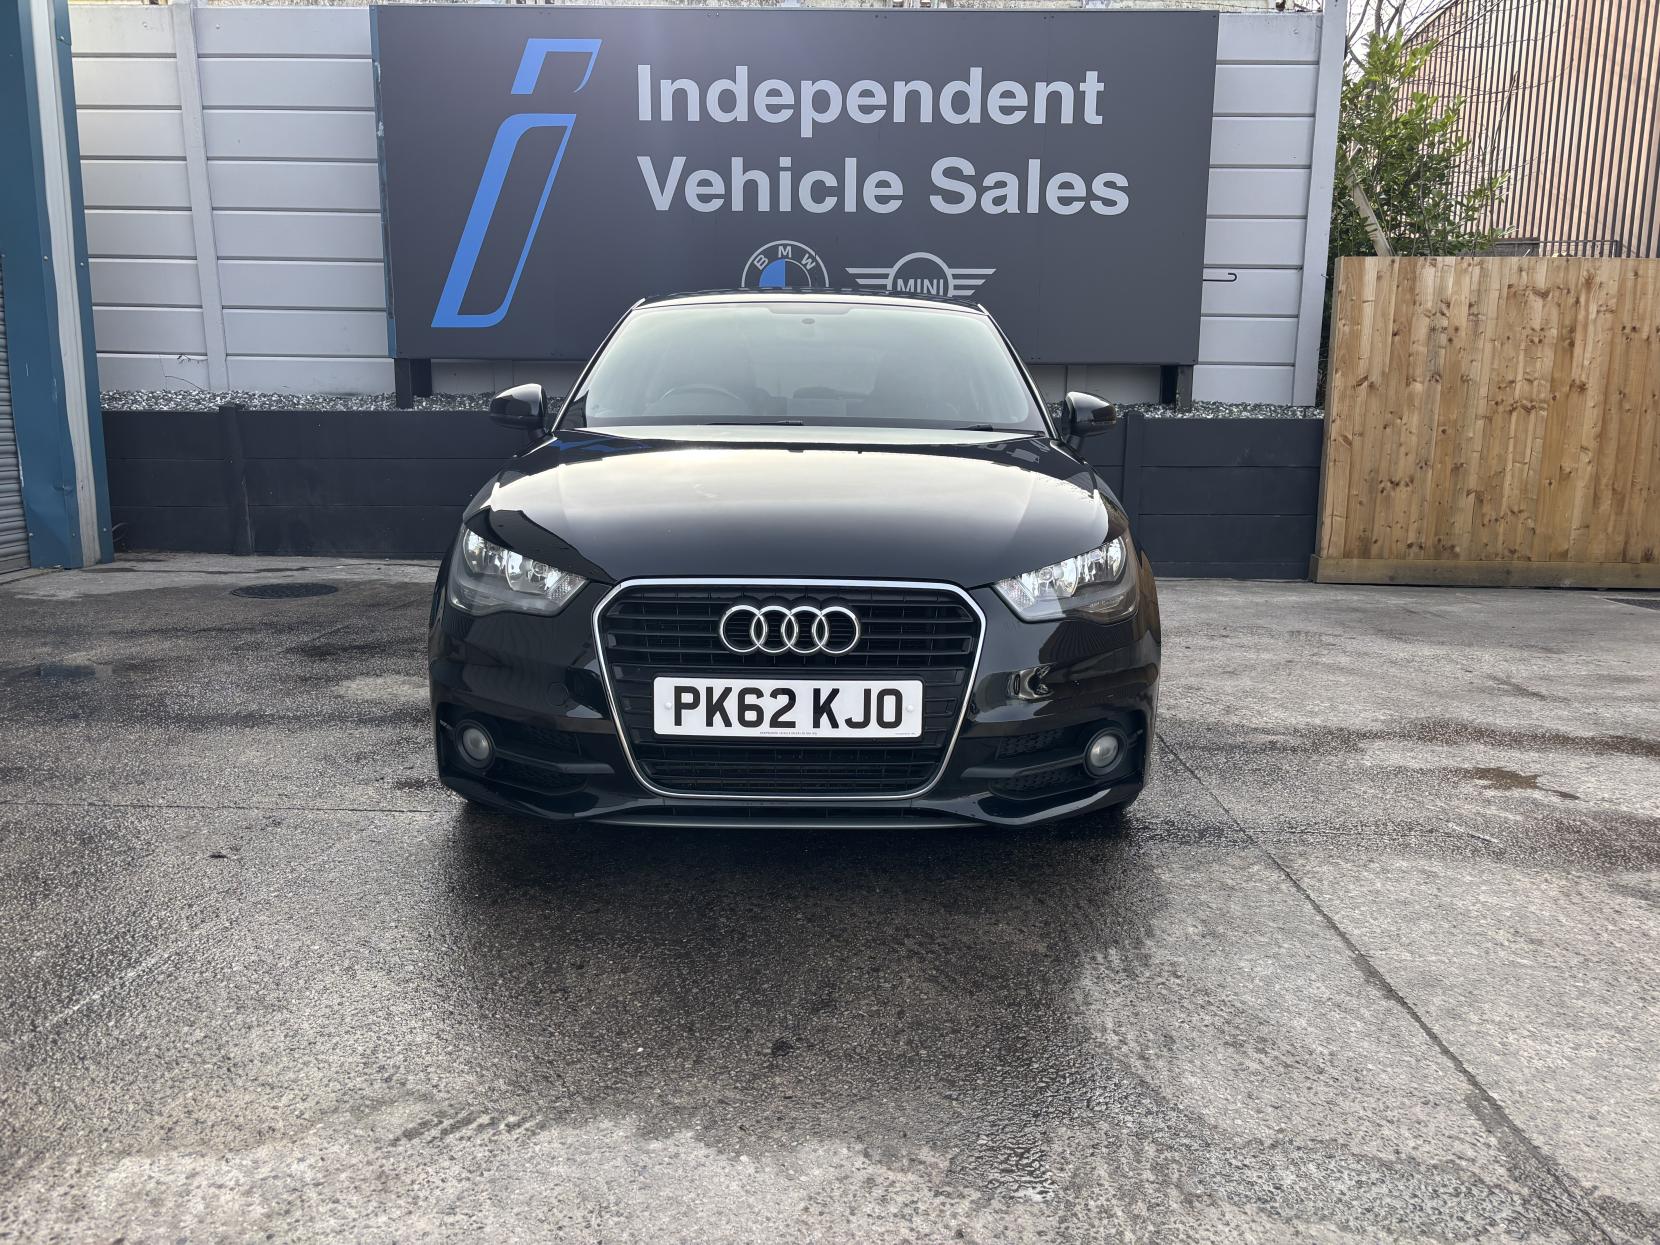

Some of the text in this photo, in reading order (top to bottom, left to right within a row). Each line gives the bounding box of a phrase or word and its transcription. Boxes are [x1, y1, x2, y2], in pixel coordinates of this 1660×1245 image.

[637, 64, 1105, 138] Independent
[637, 156, 1130, 216] Vehicle Sales
[753, 245, 816, 271] BMW
[897, 278, 944, 296] MINI
[674, 686, 904, 730] PK62 KJO
